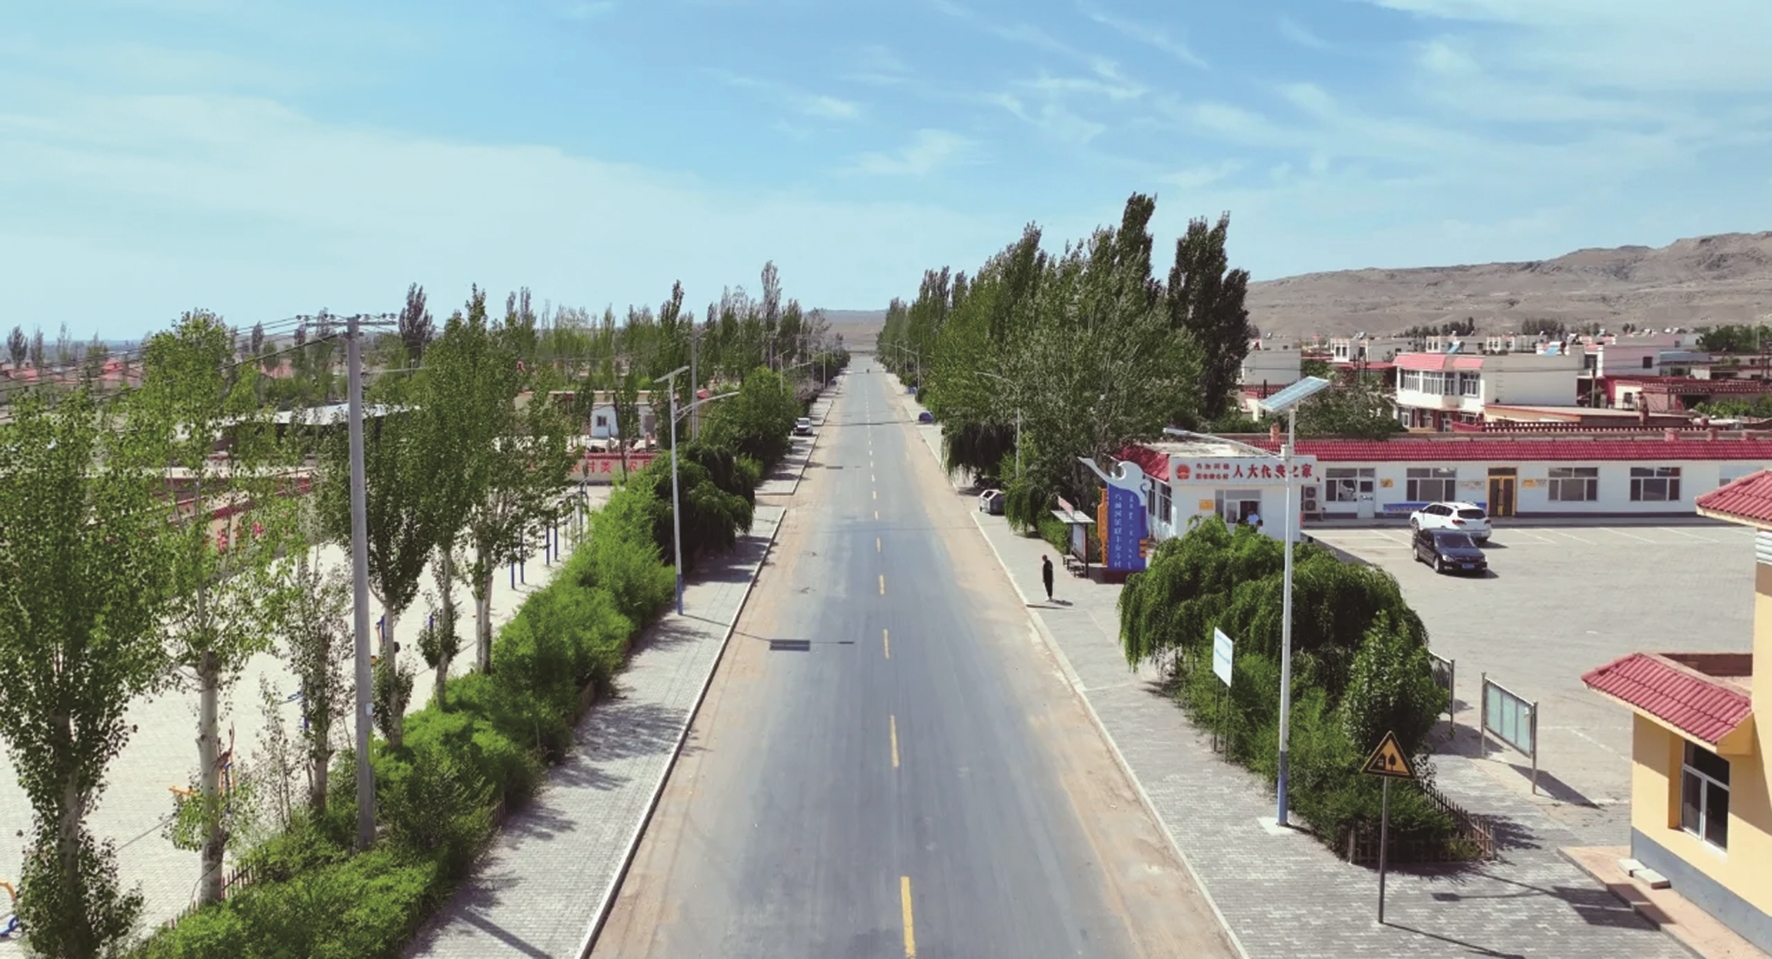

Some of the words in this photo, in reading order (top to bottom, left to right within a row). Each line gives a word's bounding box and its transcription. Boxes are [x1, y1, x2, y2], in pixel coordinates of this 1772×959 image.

[1233, 463, 1312, 479] 人大代表之家
